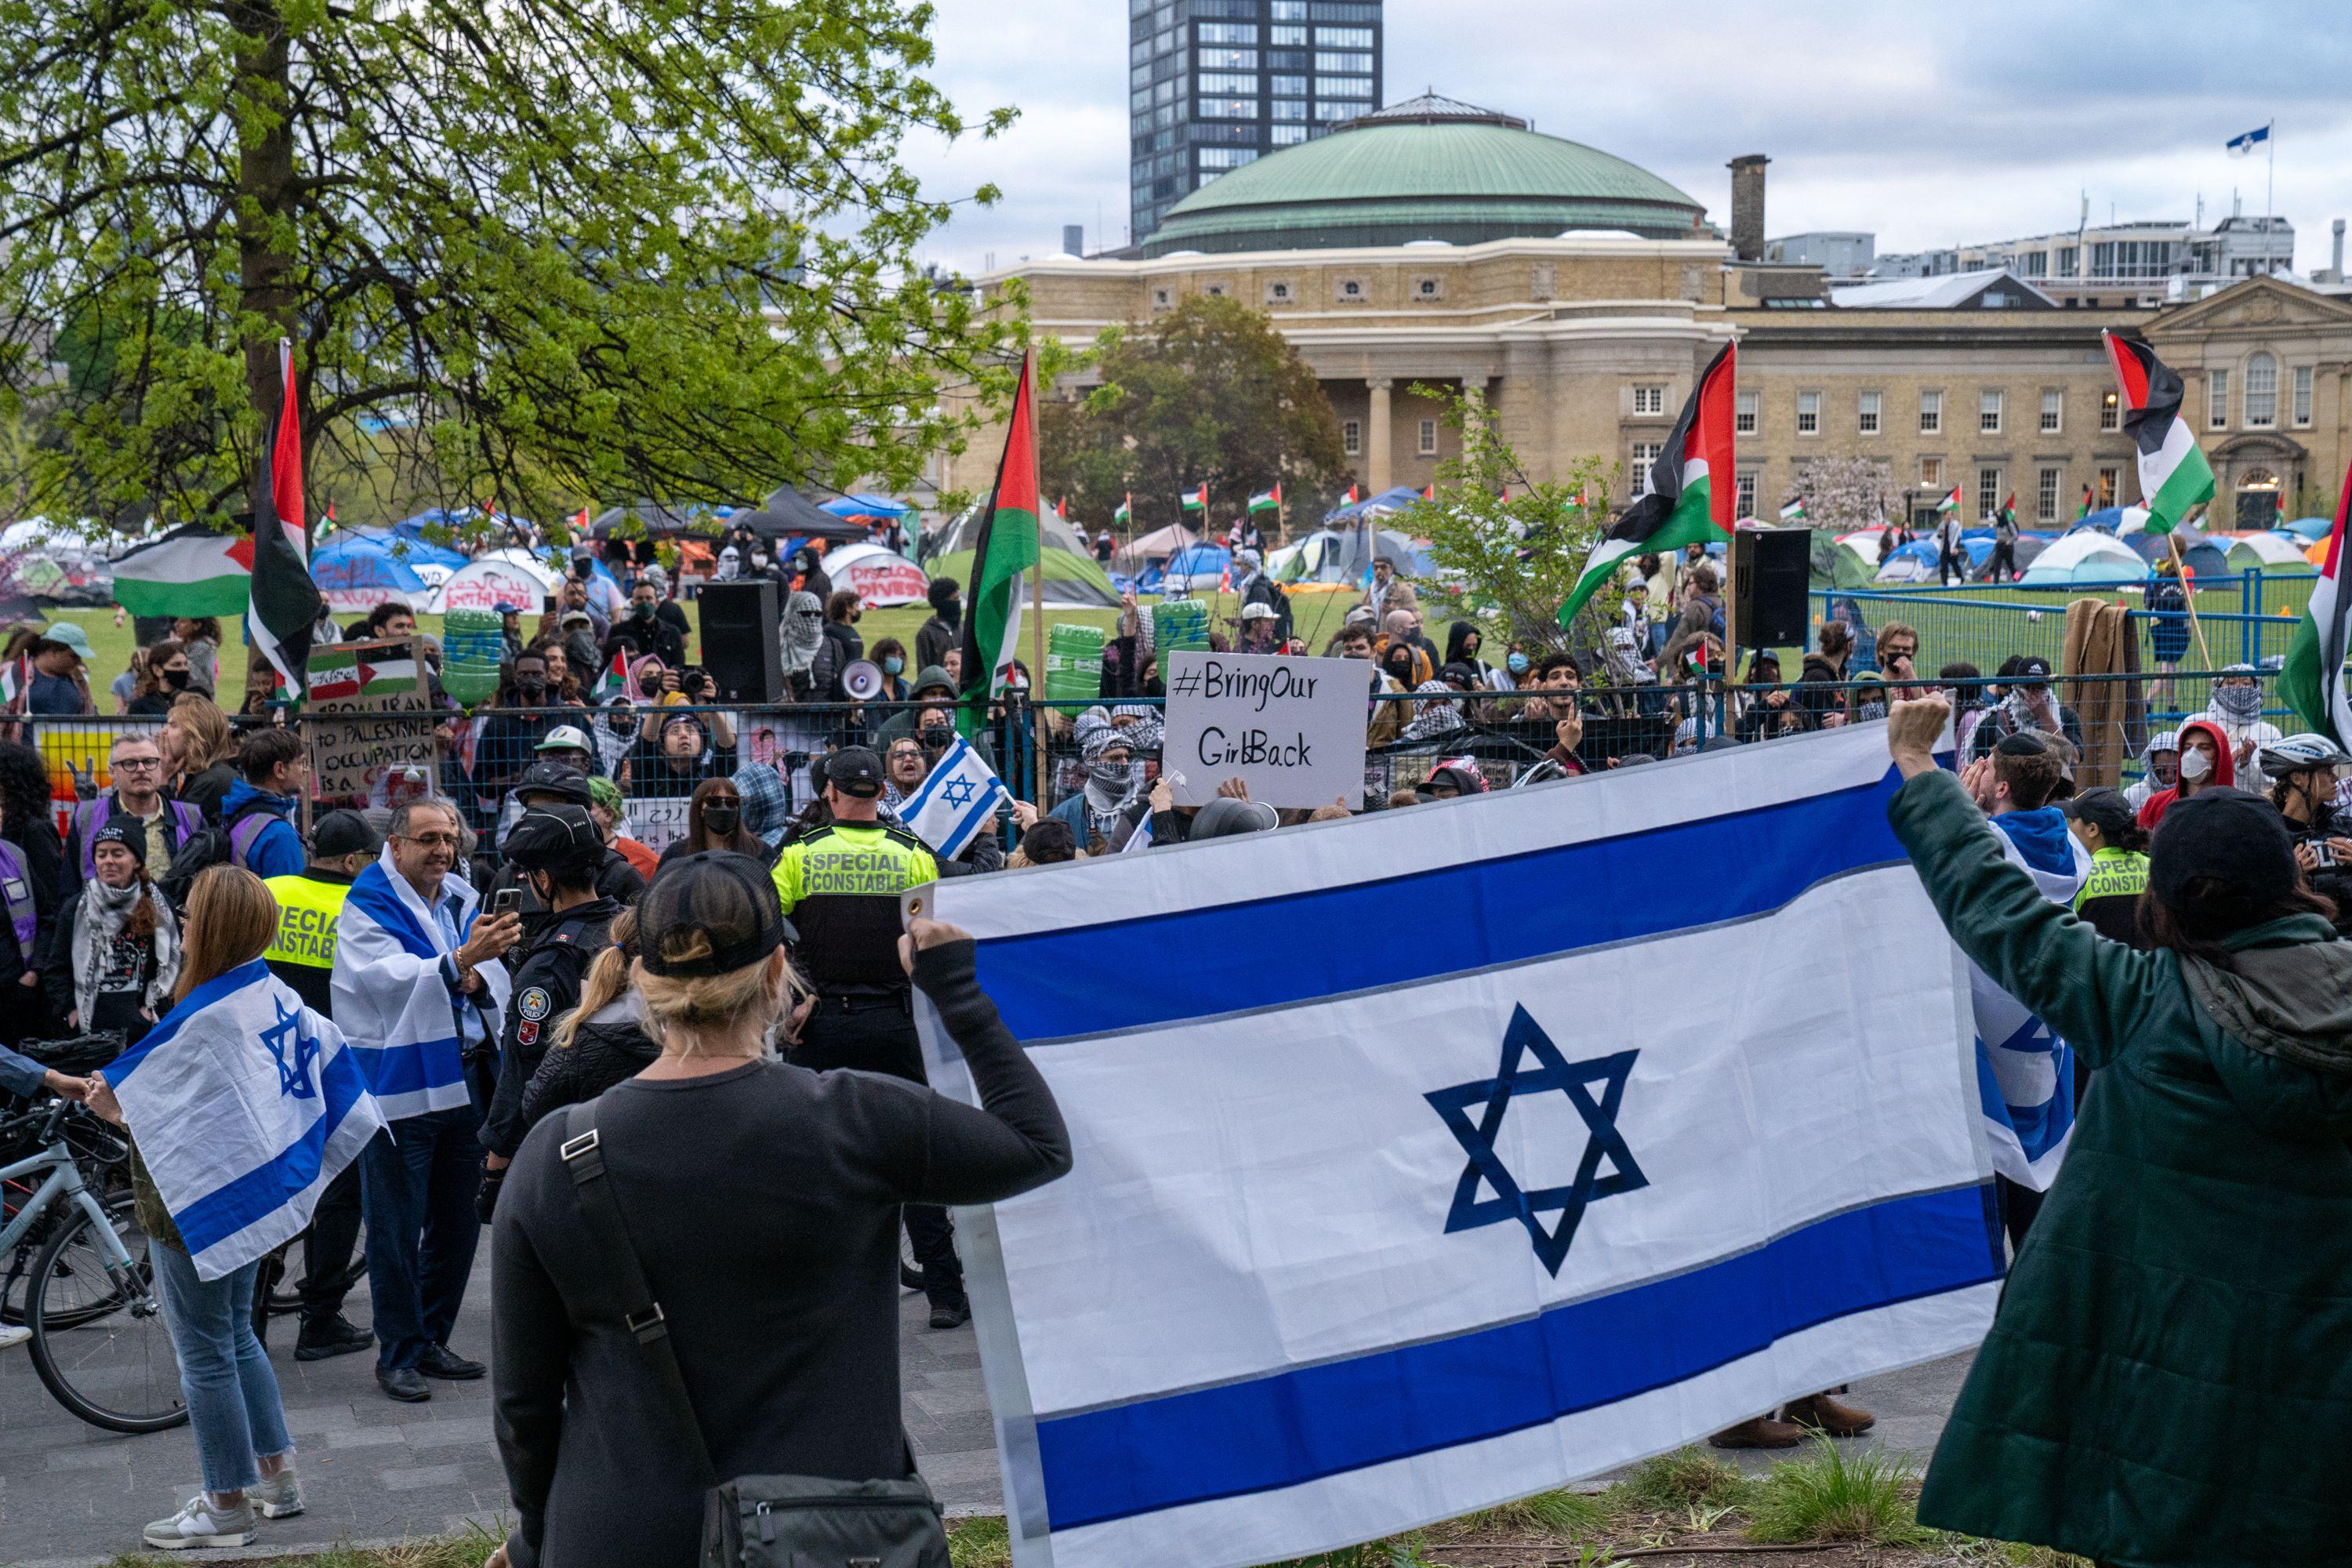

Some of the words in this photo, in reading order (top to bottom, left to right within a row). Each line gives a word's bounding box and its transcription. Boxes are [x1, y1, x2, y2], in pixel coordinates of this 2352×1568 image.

[1173, 660, 1319, 712] #BringOur
[381, 695, 426, 712] IRAN
[344, 717, 430, 744] PALESTINE
[325, 742, 433, 771] OCCUPATION
[2274, 746, 2325, 759] POLICE
[812, 853, 906, 873] SPECIAL
[811, 872, 906, 892] CONSTABLE
[2090, 875, 2150, 894] CONSTA
[523, 1008, 541, 1018] POLICE
